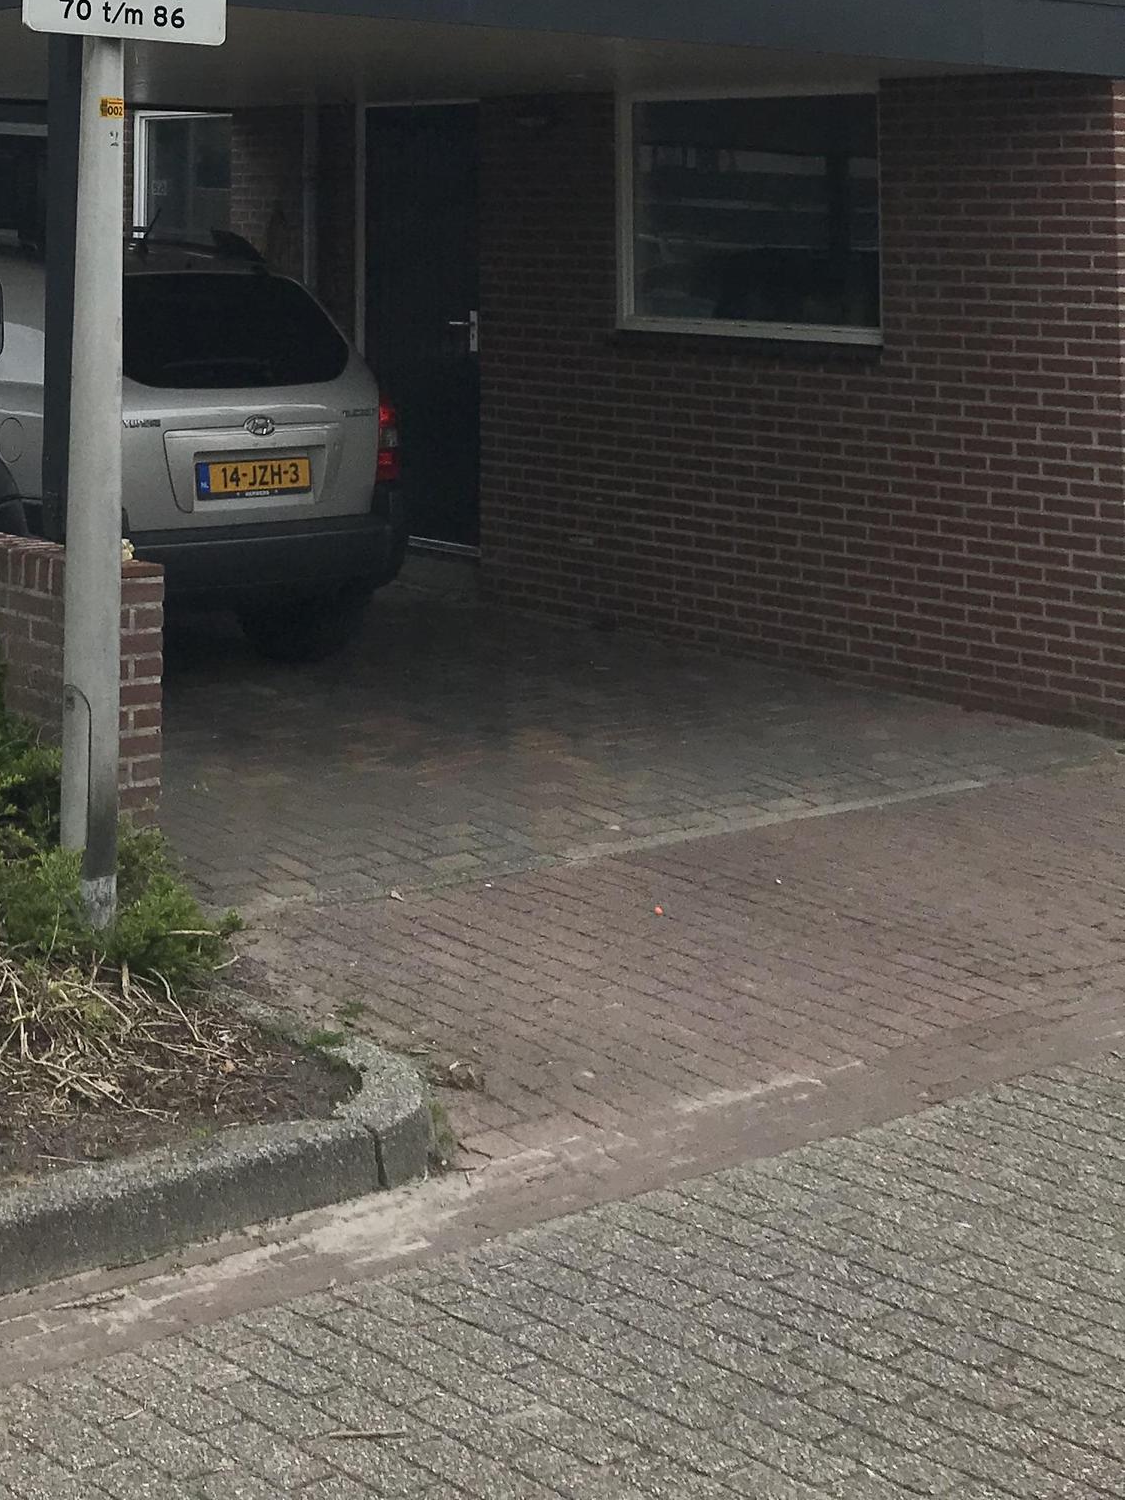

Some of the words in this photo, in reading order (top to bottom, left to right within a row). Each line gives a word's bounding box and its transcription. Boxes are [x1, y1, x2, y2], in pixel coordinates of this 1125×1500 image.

[102, 1, 143, 25] t/m
[153, 5, 185, 29] 86
[107, 105, 123, 116] 002
[221, 463, 300, 489] 14-JZH-3
